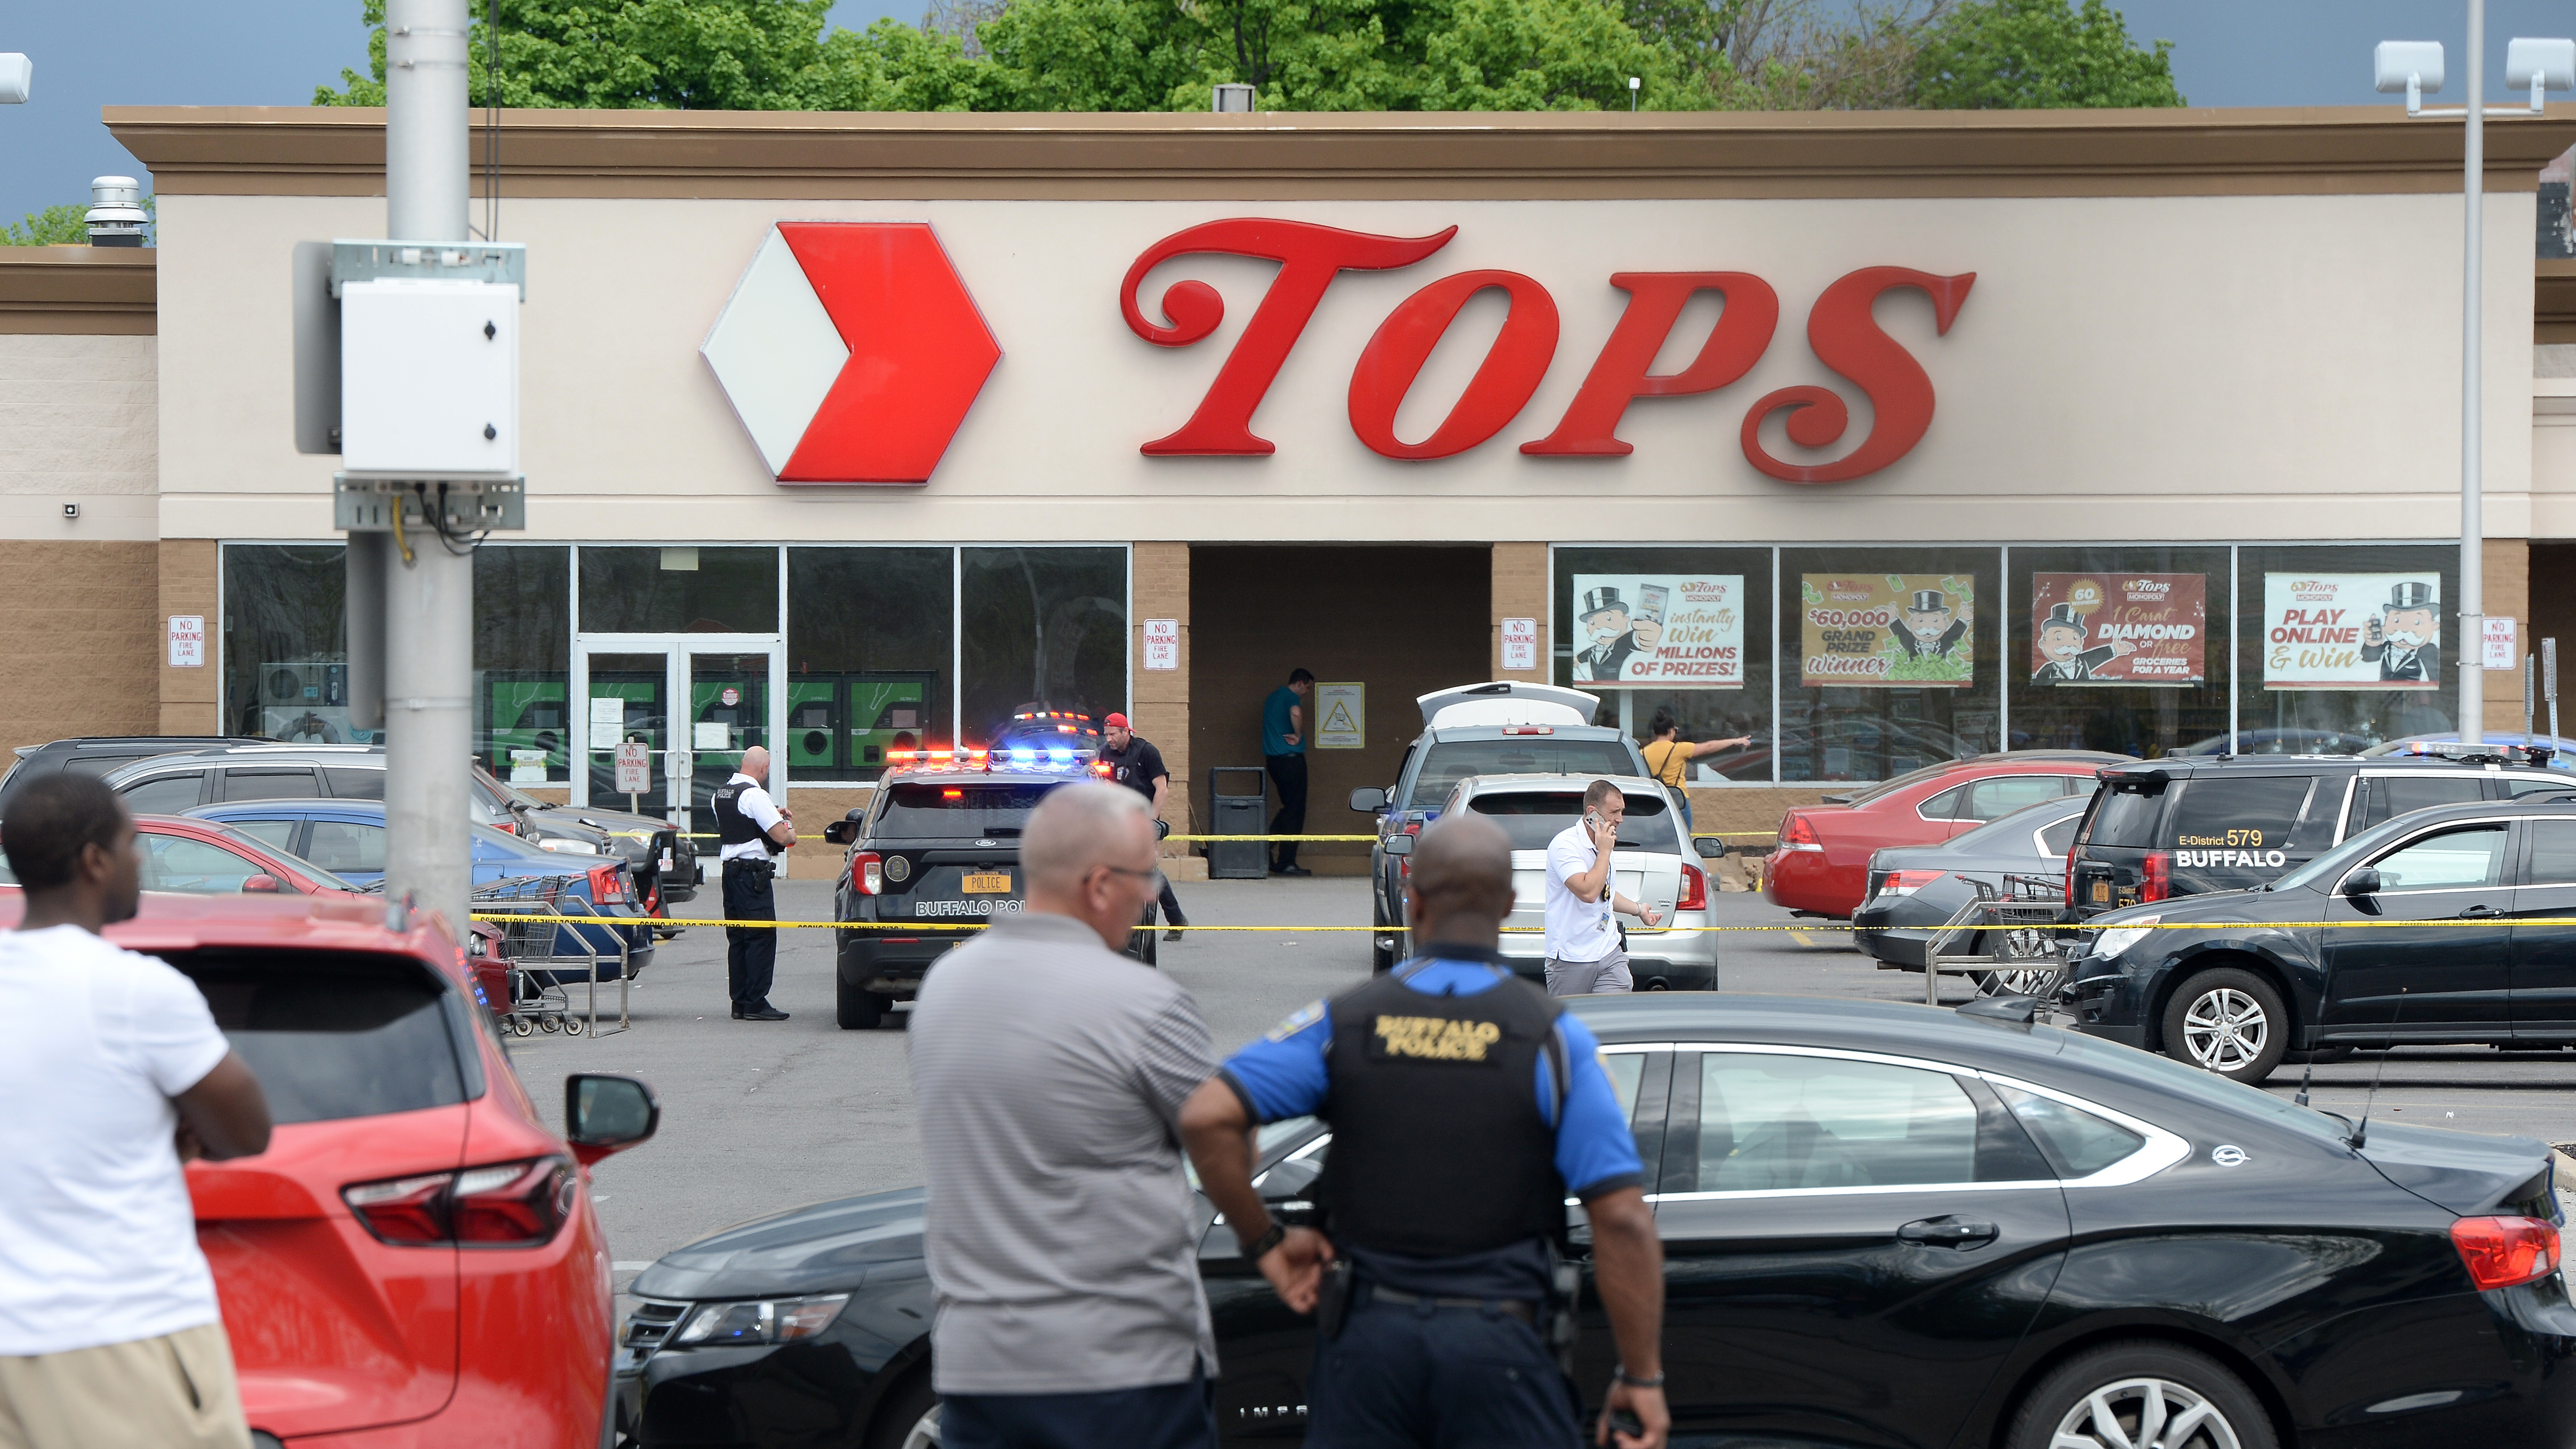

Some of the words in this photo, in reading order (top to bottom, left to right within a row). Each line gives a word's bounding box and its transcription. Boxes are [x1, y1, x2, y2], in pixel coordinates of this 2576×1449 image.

[1119, 216, 1977, 484] TOPS
[2075, 588, 2095, 600] 60
[1670, 608, 1736, 632] instantly
[1810, 610, 1890, 628] $60,000
[2125, 607, 2177, 624] Carat
[2283, 609, 2346, 625] PLAY
[180, 621, 192, 630] NO
[1154, 624, 1167, 633] NO
[1513, 623, 1525, 632] NO
[2492, 623, 2505, 632] NO
[171, 632, 202, 641] PARKING
[1822, 631, 1876, 642] GRAND
[2098, 624, 2195, 640] DIAMOND
[2270, 627, 2360, 643] ONLINE
[1147, 635, 1176, 644] PARKING
[1505, 634, 1534, 643] PARKING
[2484, 634, 2514, 643] PARKING
[1655, 647, 1737, 659] MILLIONS
[1826, 642, 1872, 653] PRIZE
[2151, 638, 2192, 658] free
[1807, 656, 1894, 674] winner
[2132, 658, 2188, 666] GROCERIES
[2270, 646, 2292, 672] &
[1631, 662, 1658, 675] OF
[1662, 662, 1737, 675] PRIZES!
[2132, 666, 2153, 674] FOR
[2154, 666, 2163, 674] A
[2164, 666, 2190, 674] YEAR
[625, 749, 637, 757] NO
[618, 758, 646, 767] PARKING
[2179, 836, 2225, 846] E-District
[2227, 829, 2263, 846] 579
[2176, 850, 2286, 867] BUFFALO
[972, 877, 1001, 889] POLICE
[916, 900, 992, 916] BUFFALO
[995, 900, 1026, 915] POL
[1375, 1015, 1501, 1044] BUFFALO
[1386, 1034, 1487, 1061] POLICE
[1240, 1405, 1308, 1418] IMPA
